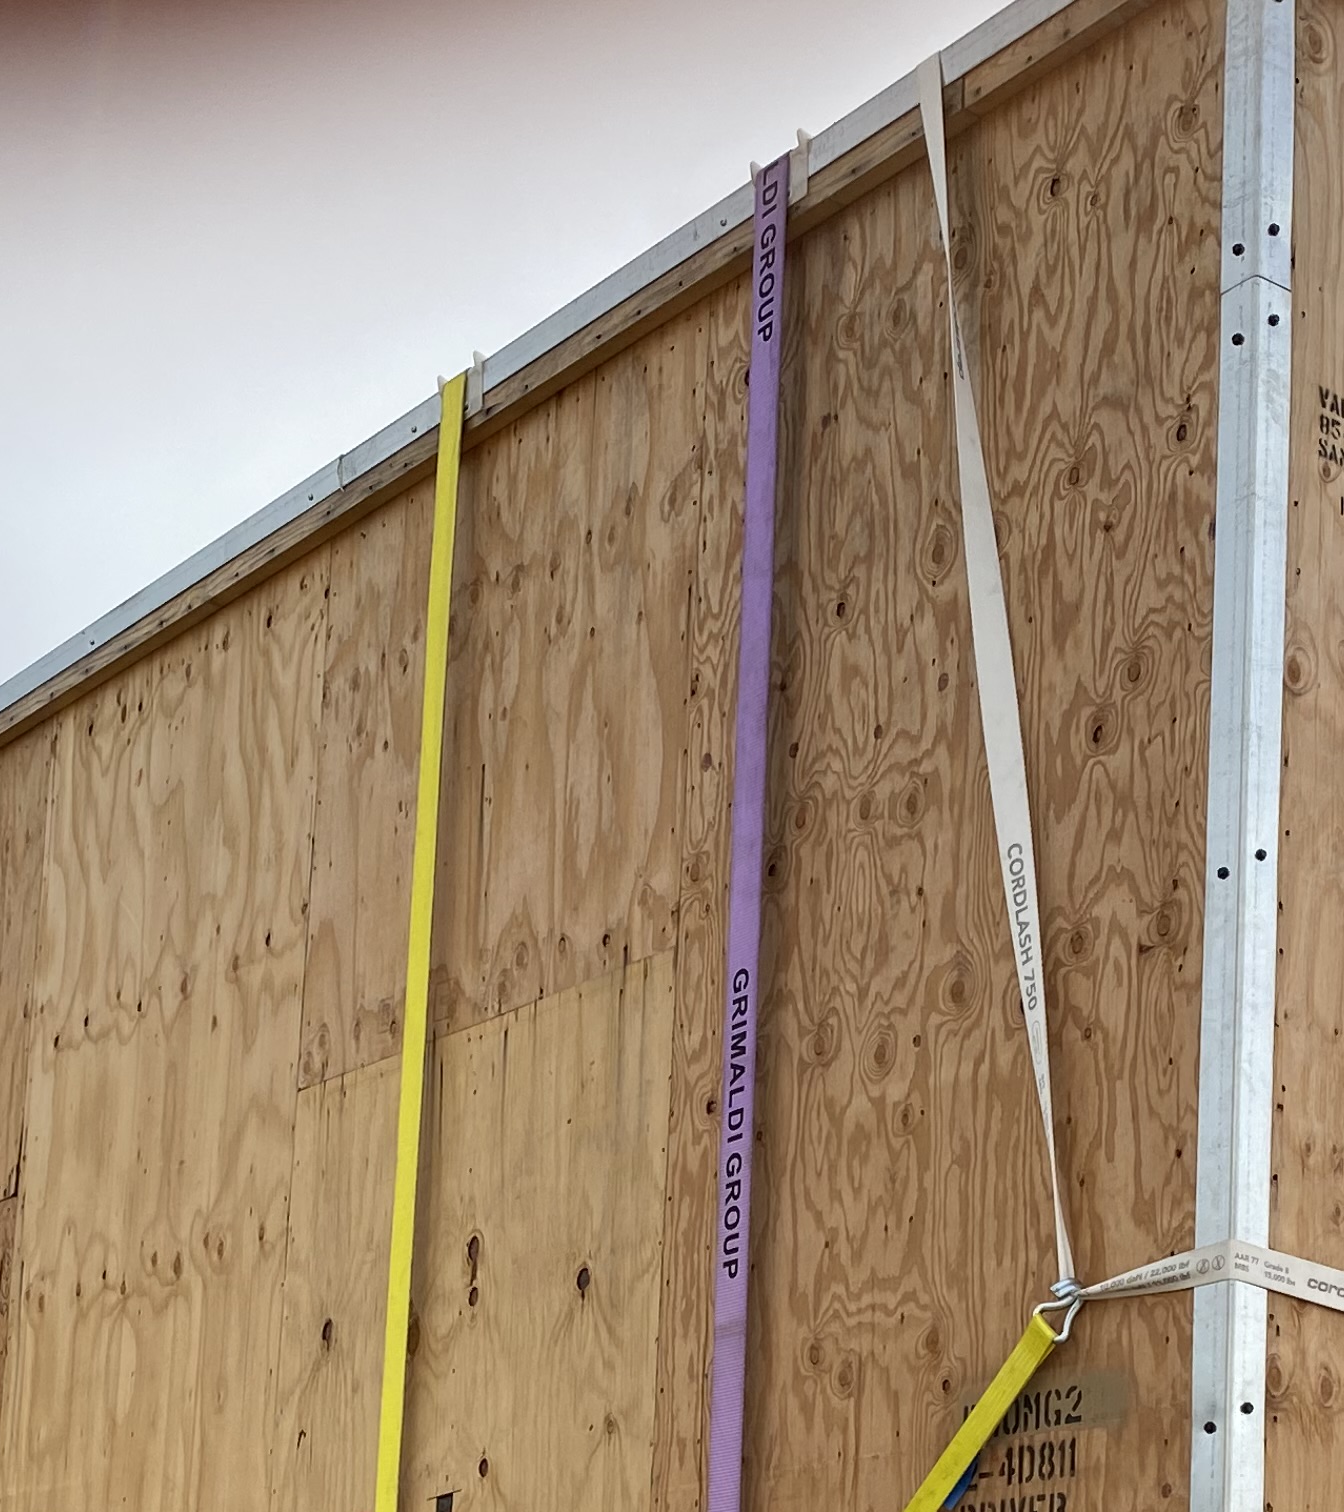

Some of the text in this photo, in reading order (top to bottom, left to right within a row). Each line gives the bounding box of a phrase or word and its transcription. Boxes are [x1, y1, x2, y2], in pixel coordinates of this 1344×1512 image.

[757, 223, 776, 342] GROUP
[1007, 843, 1033, 967] CORDLASH
[1023, 968, 1038, 1011] 750
[722, 968, 750, 1280] GRIMALDI GROUP
[963, 1385, 1083, 1437] OMG2
